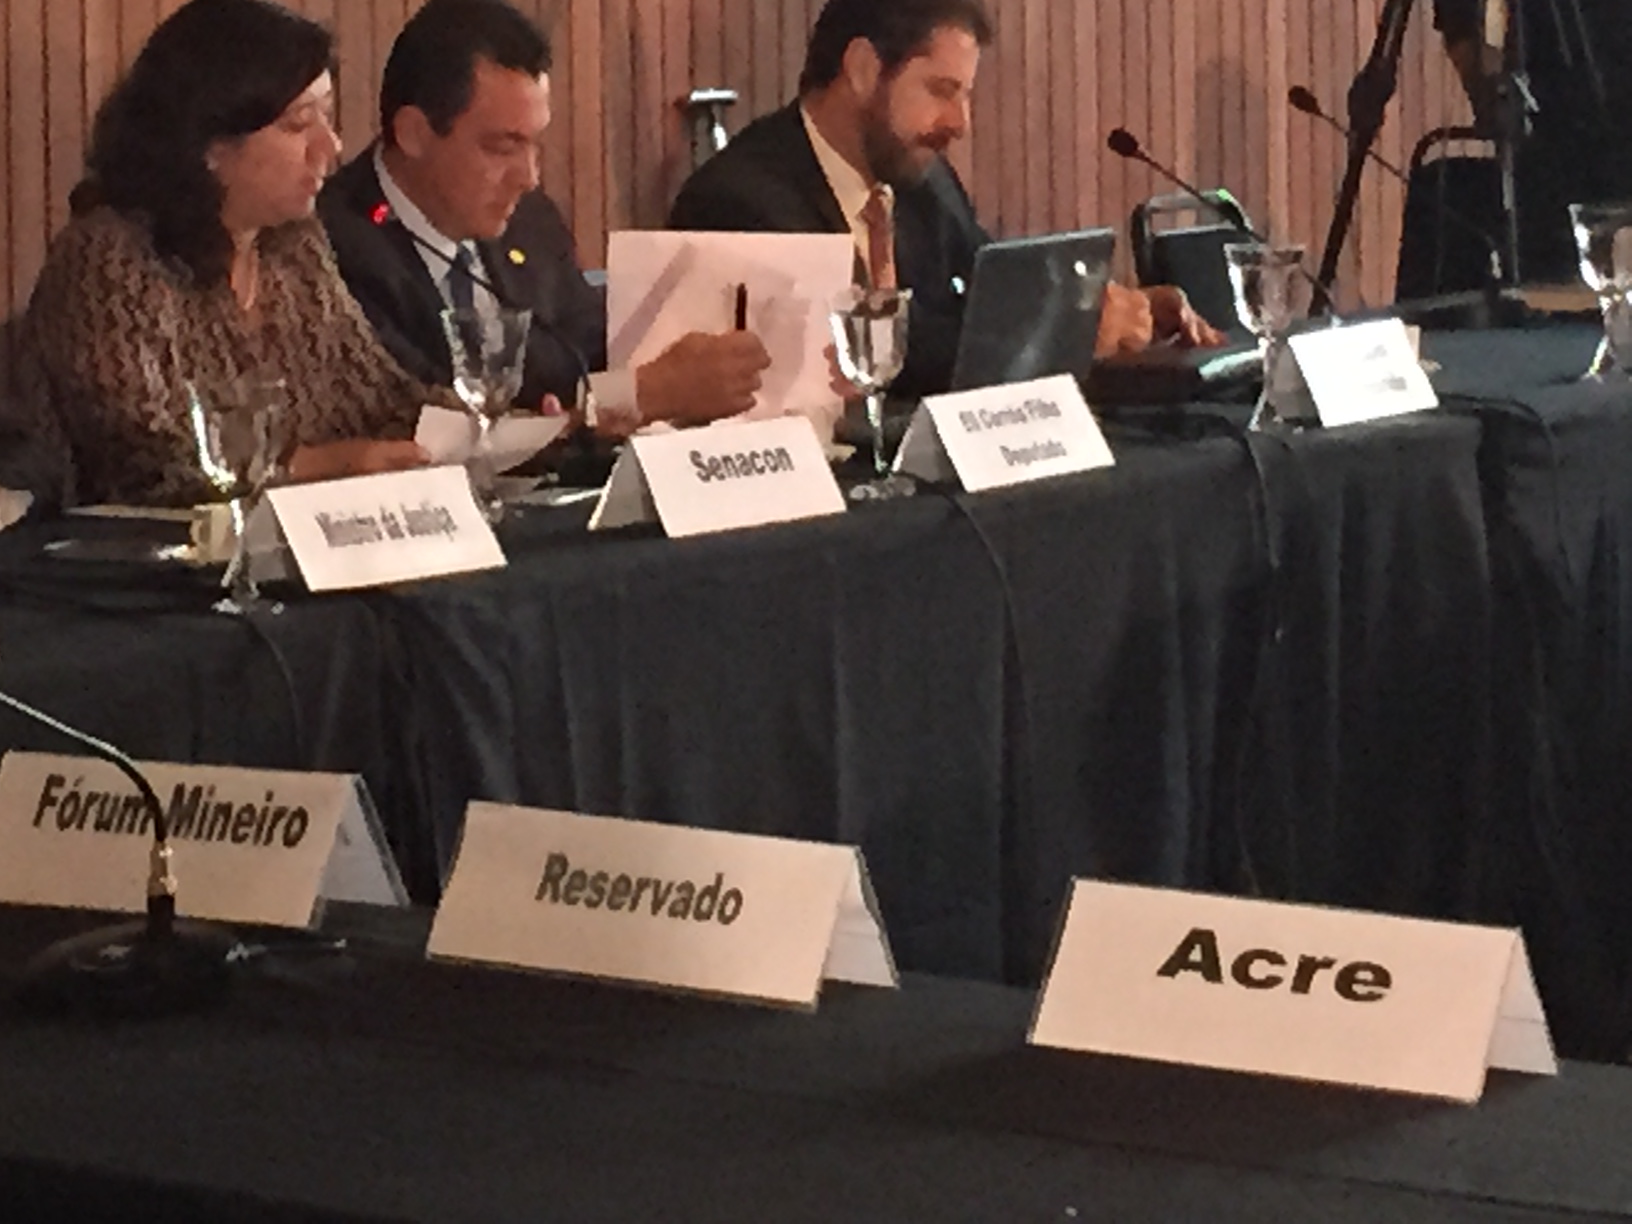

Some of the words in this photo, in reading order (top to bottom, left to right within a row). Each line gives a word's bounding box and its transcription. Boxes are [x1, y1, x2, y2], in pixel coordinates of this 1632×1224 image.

[689, 446, 795, 483] Senacon
[170, 781, 310, 849] Mineiro
[534, 850, 744, 926] Reservado
[1156, 927, 1393, 1003] Acre
